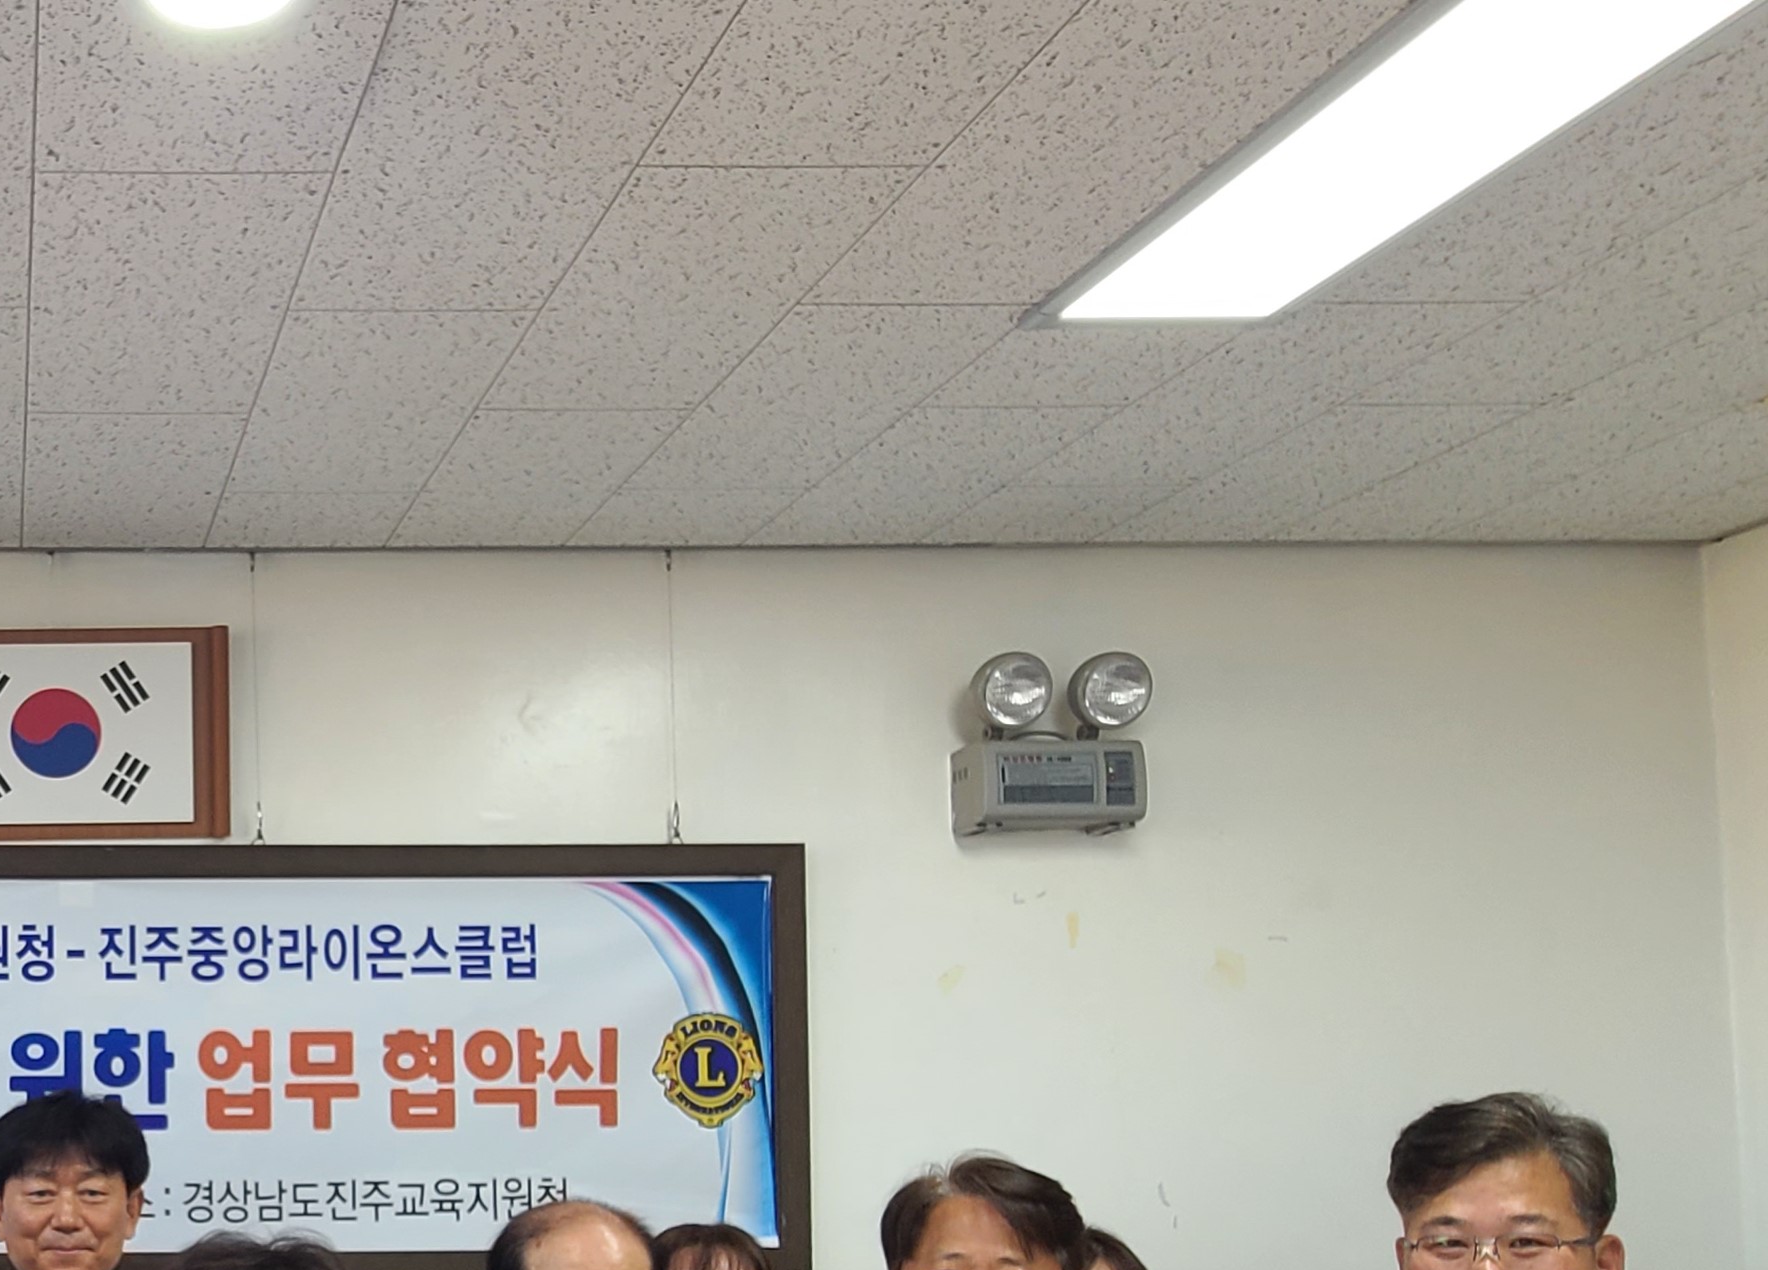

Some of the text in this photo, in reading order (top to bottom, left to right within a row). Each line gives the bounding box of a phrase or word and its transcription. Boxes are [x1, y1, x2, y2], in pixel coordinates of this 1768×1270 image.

[679, 1019, 738, 1039] LIONS
[9, 1028, 175, 1131] 위한
[197, 1028, 360, 1131] 업무
[382, 1027, 619, 1129] 협약식
[694, 1046, 726, 1087] L
